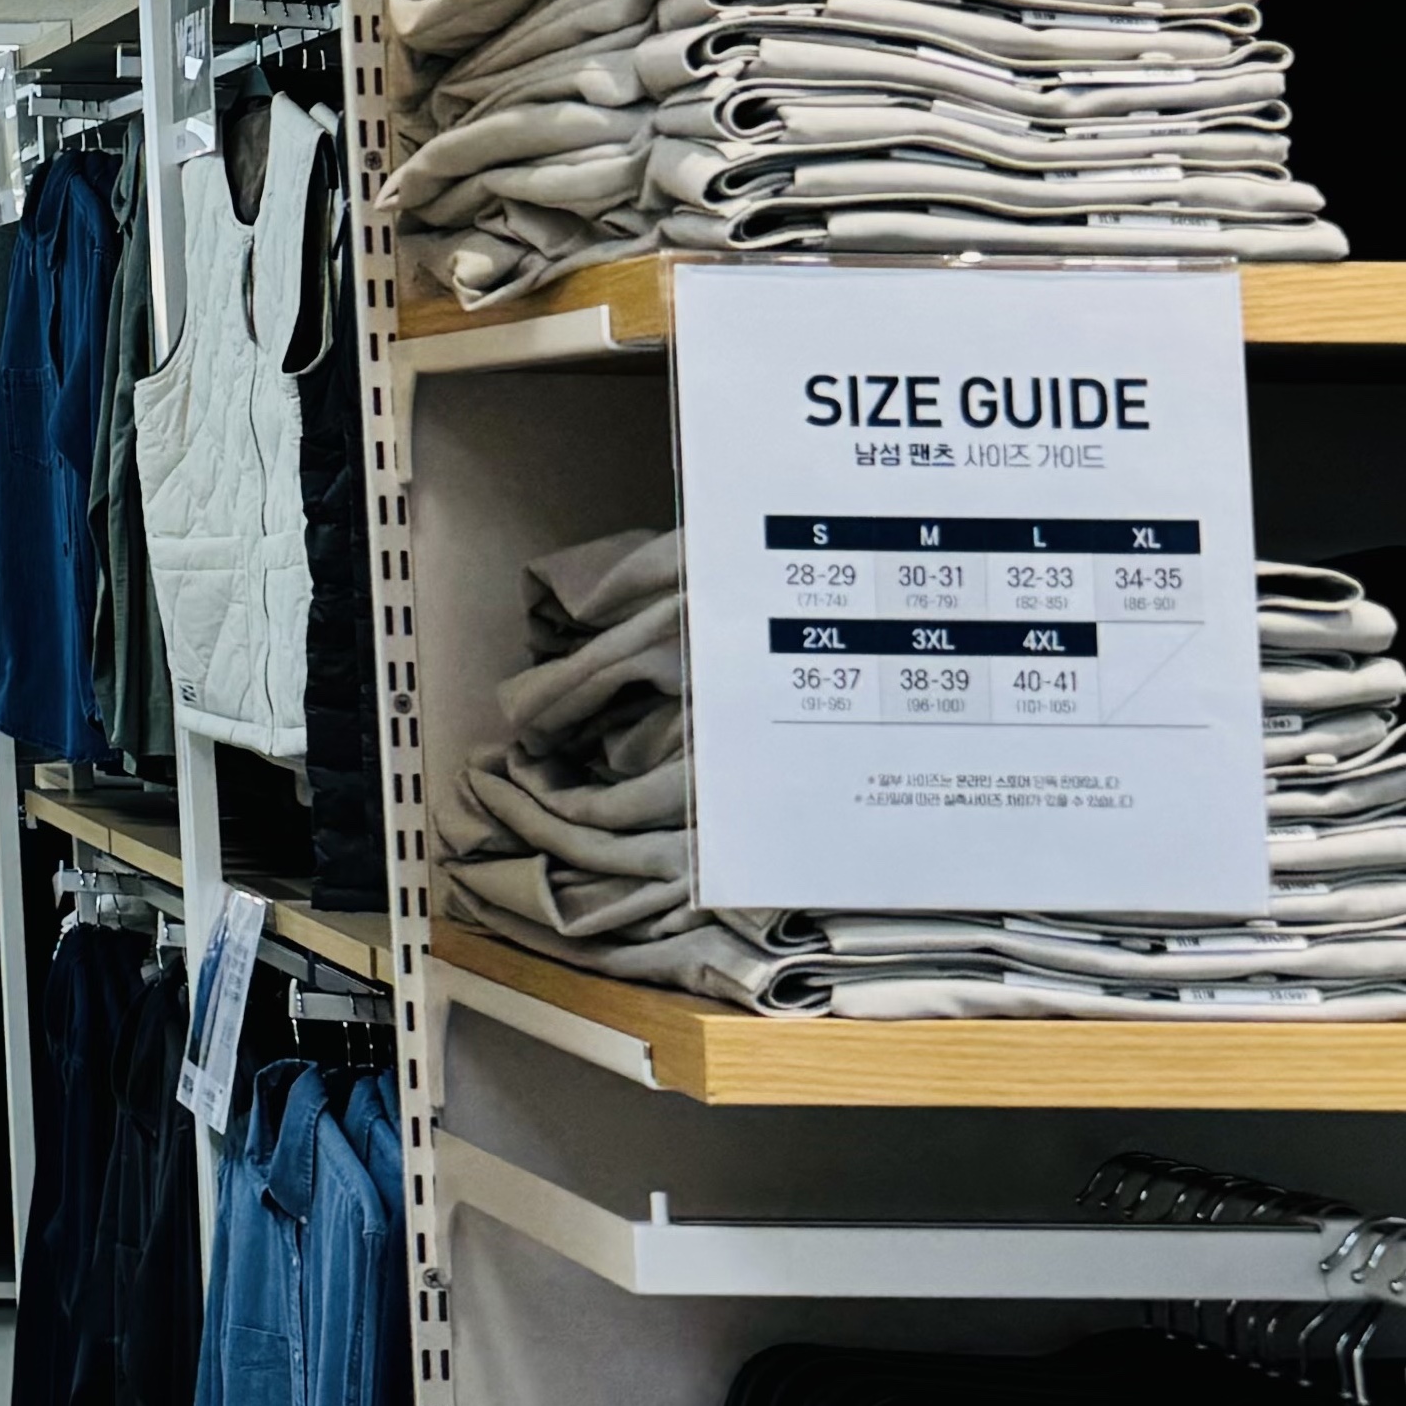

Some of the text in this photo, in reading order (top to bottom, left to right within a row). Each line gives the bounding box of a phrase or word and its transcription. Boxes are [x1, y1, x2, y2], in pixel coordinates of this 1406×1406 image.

[806, 375, 1149, 429] SIZE GUIDE
[856, 444, 1104, 468] 남성 팬츠 사이즈 가이드
[813, 524, 1160, 548] S M L XL
[786, 564, 1182, 589] 28-29 30-31 32-33 34-35
[803, 628, 1064, 651] 2XL 3XL 4XL
[793, 668, 1076, 691] 36-37 38-39 40-41
